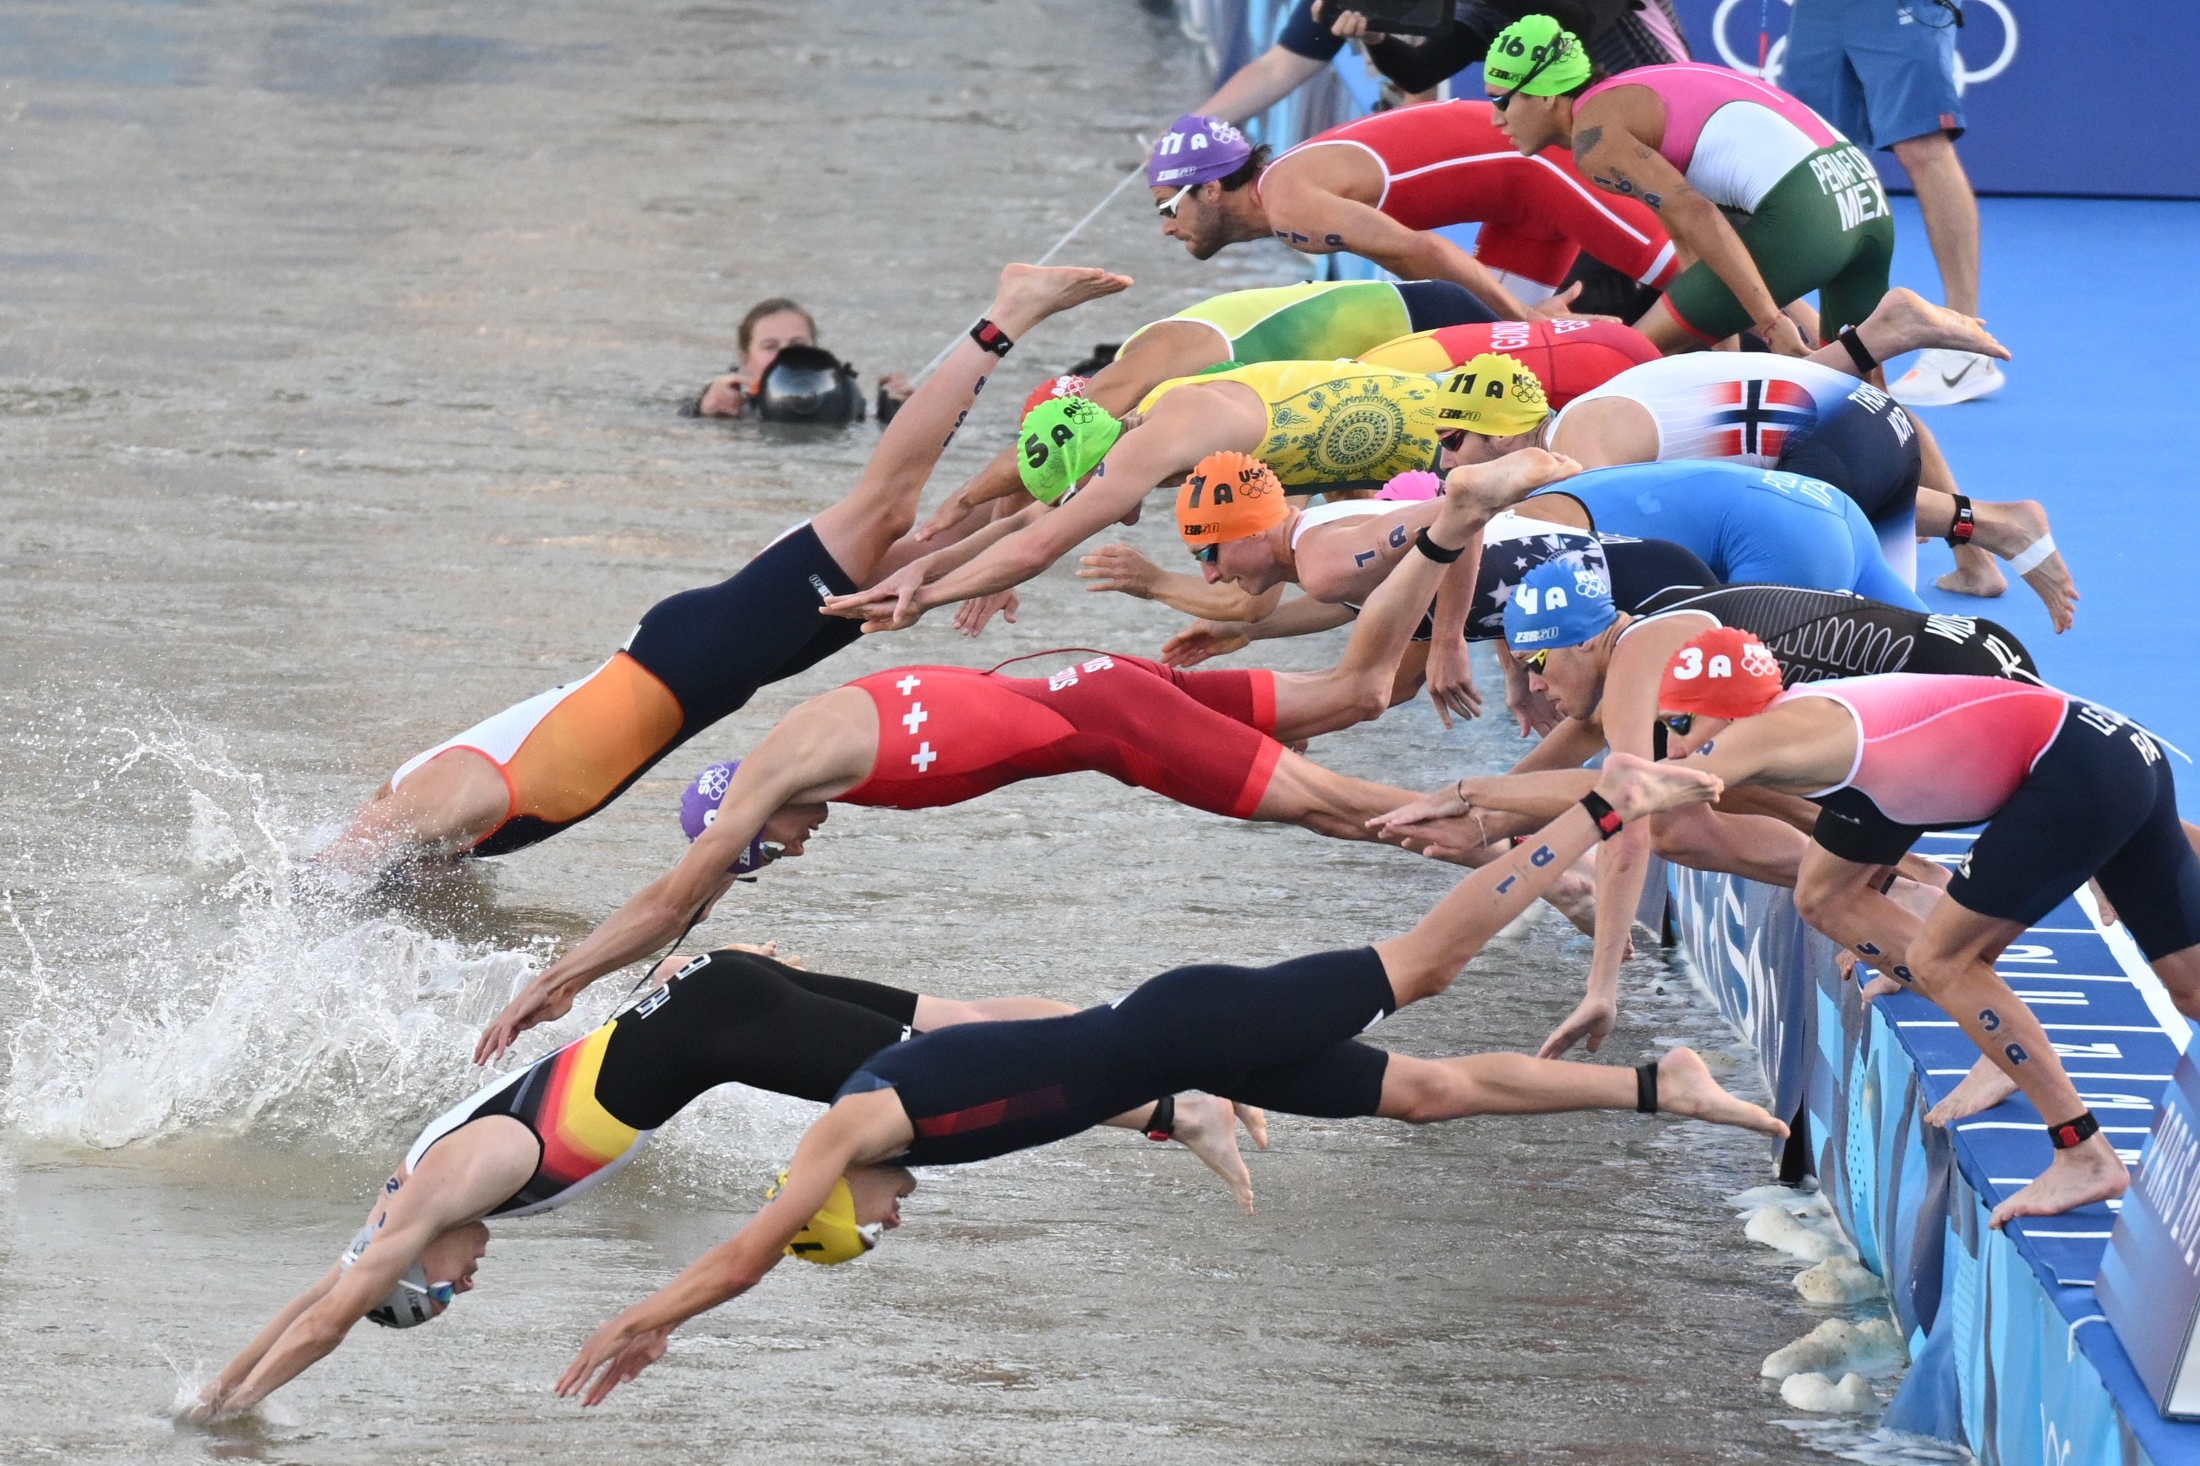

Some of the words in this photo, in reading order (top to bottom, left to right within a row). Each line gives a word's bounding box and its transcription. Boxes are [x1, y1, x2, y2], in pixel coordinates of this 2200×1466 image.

[1497, 35, 1525, 57] 16
[1160, 132, 1185, 155] 17
[1191, 133, 1208, 150] A
[1835, 178, 1890, 232] MEX
[1449, 372, 1477, 394] 11
[1485, 380, 1504, 399] A
[1886, 406, 1914, 448] NOR
[1024, 432, 1049, 469] 5
[1050, 423, 1075, 448] A
[1213, 482, 1234, 505] A
[1799, 479, 1836, 508] ITA
[1515, 583, 1538, 615] 4
[1545, 586, 1568, 611] A
[1673, 647, 1703, 680] 3
[1708, 654, 1732, 678] A
[1978, 1008, 2000, 1031] 3
[2004, 1042, 2028, 1065] A
[2139, 1100, 2199, 1225] PARIS
